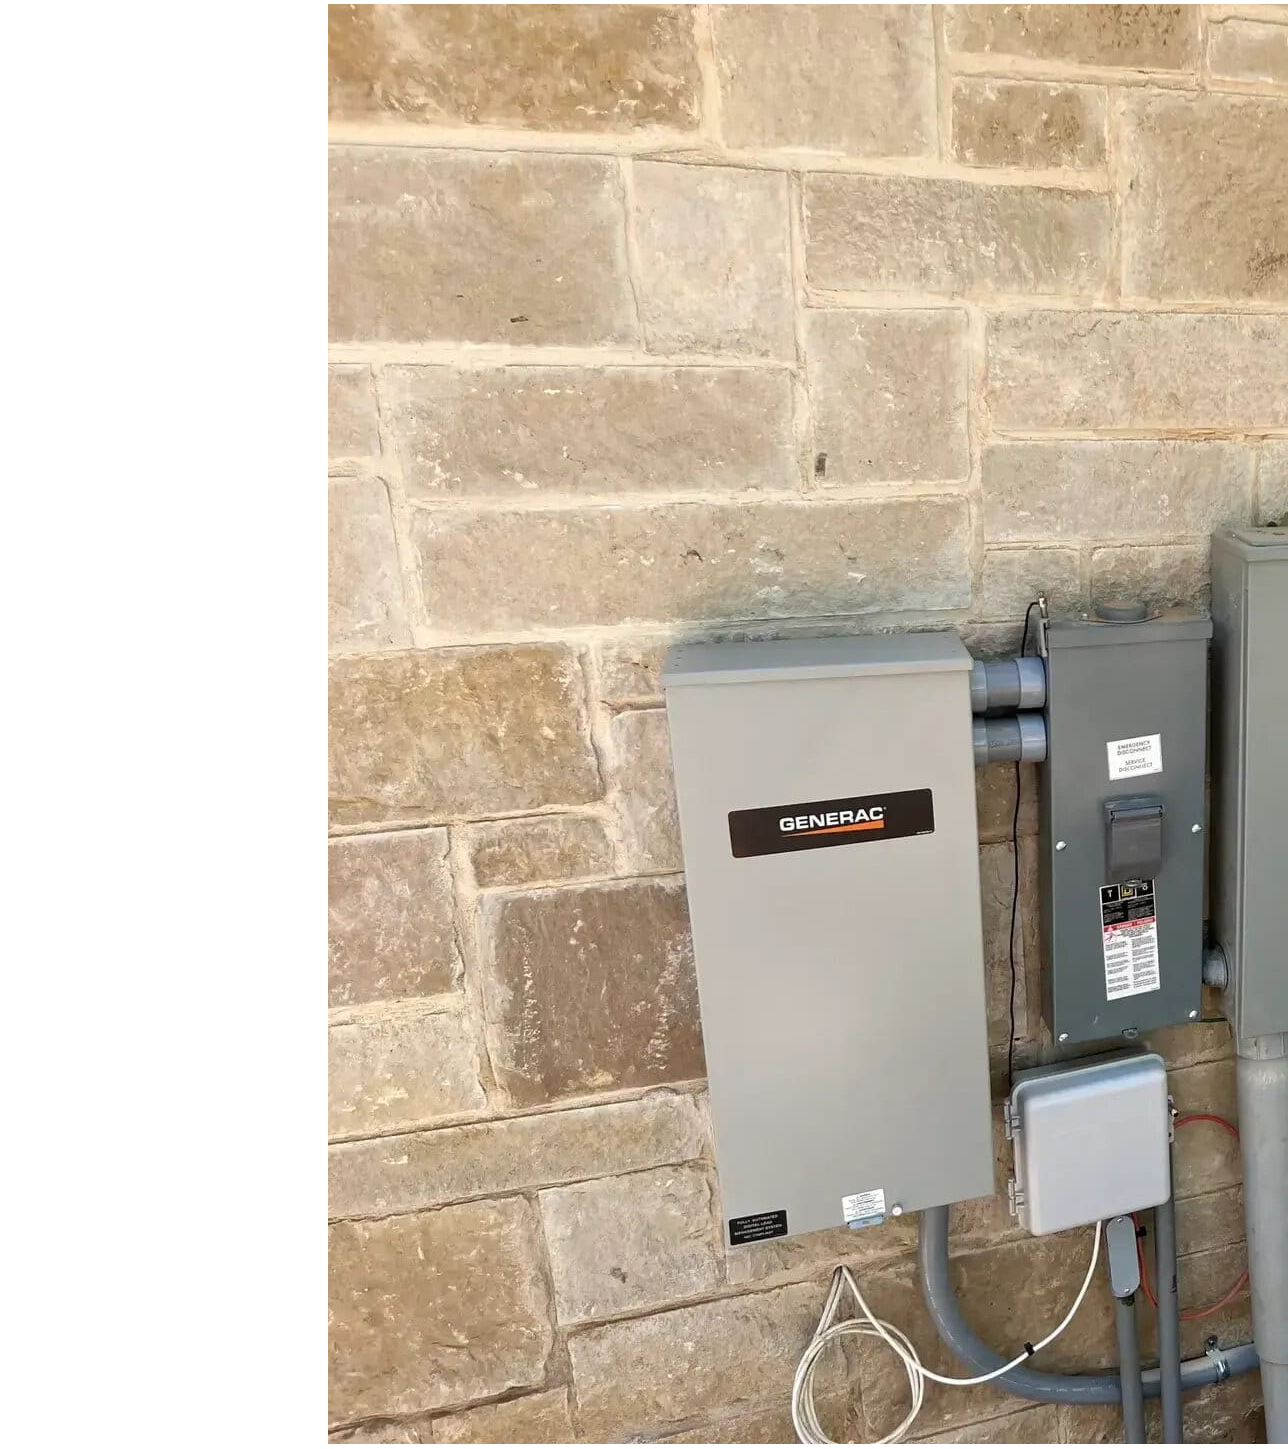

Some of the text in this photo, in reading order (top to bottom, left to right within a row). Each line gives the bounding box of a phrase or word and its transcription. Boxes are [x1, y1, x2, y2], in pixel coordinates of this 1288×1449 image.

[1118, 740, 1150, 750] EMERGENCY
[1117, 746, 1151, 756] DISCONNECT
[1119, 762, 1152, 772] DISCONNECT
[1125, 758, 1146, 766] SERVICE
[779, 806, 884, 832] GENERAC
